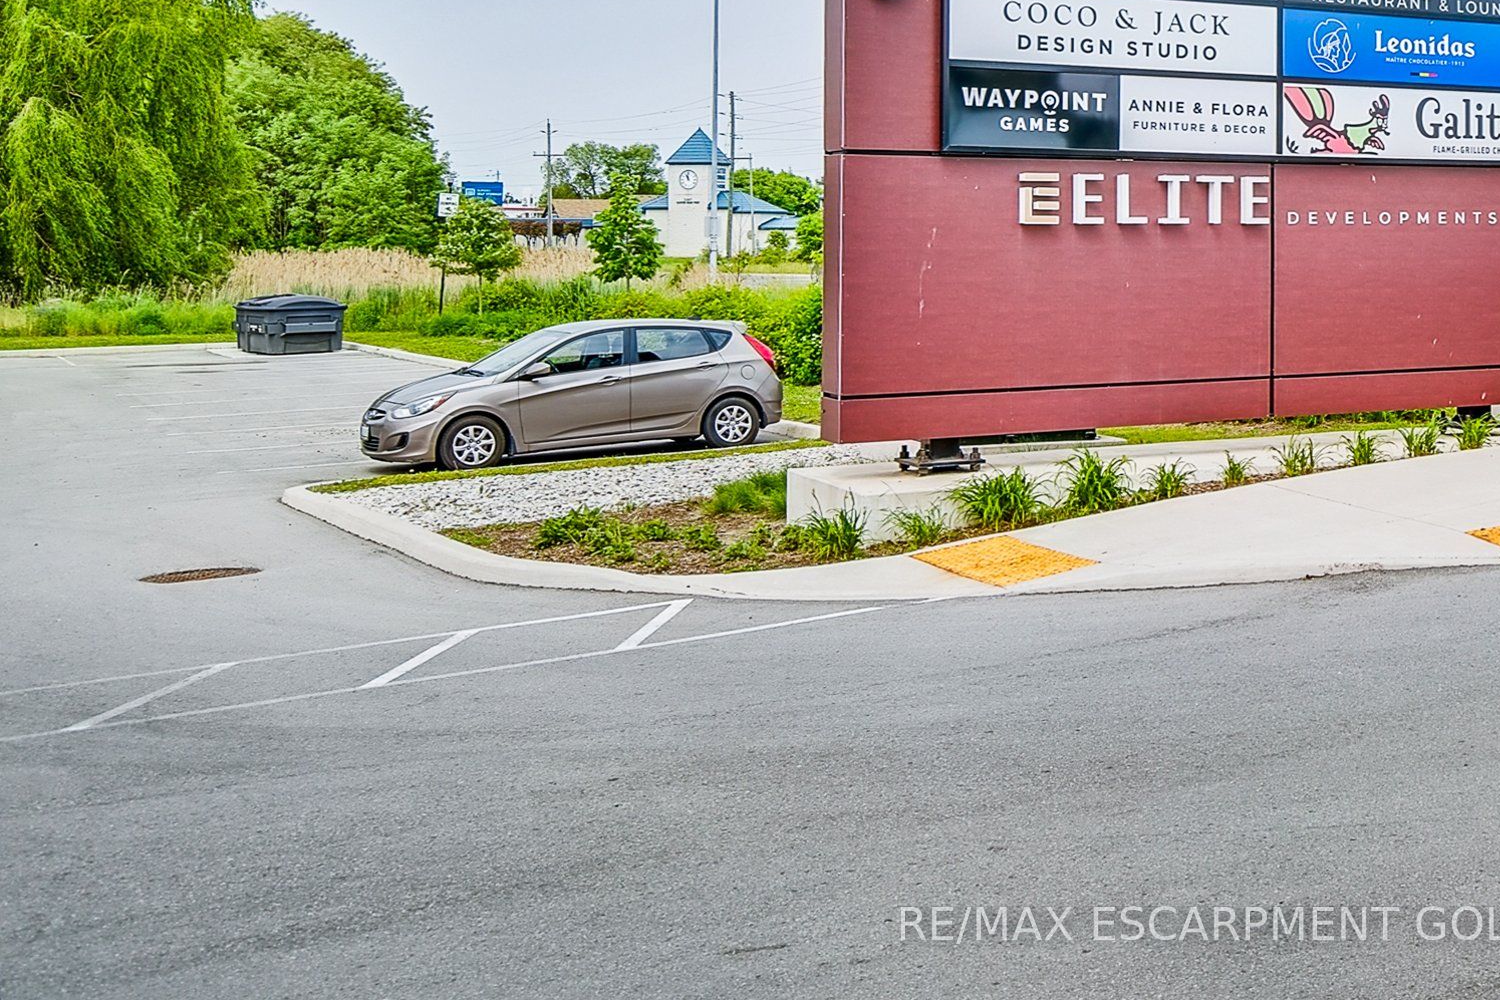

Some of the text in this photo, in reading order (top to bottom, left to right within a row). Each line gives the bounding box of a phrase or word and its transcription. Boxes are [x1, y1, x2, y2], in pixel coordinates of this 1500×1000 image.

[1439, 0, 1449, 12] &
[1003, 0, 1230, 36] COCO & JACK
[1018, 34, 1217, 61] DESIGN STUDIO
[1374, 30, 1476, 58] Leonidas
[1408, 58, 1447, 66] CHOCOLATIER
[961, 86, 1107, 115] WAYPOINT
[1128, 99, 1268, 118] ANNIE & FLORA
[999, 117, 1070, 133] GAMES
[1133, 121, 1266, 135] FURNITURE & DECOR
[1433, 145, 1490, 155] FLAME-GRILLED
[1072, 173, 1270, 226] ELITE
[1287, 211, 1499, 226] DEVELOPMENTS
